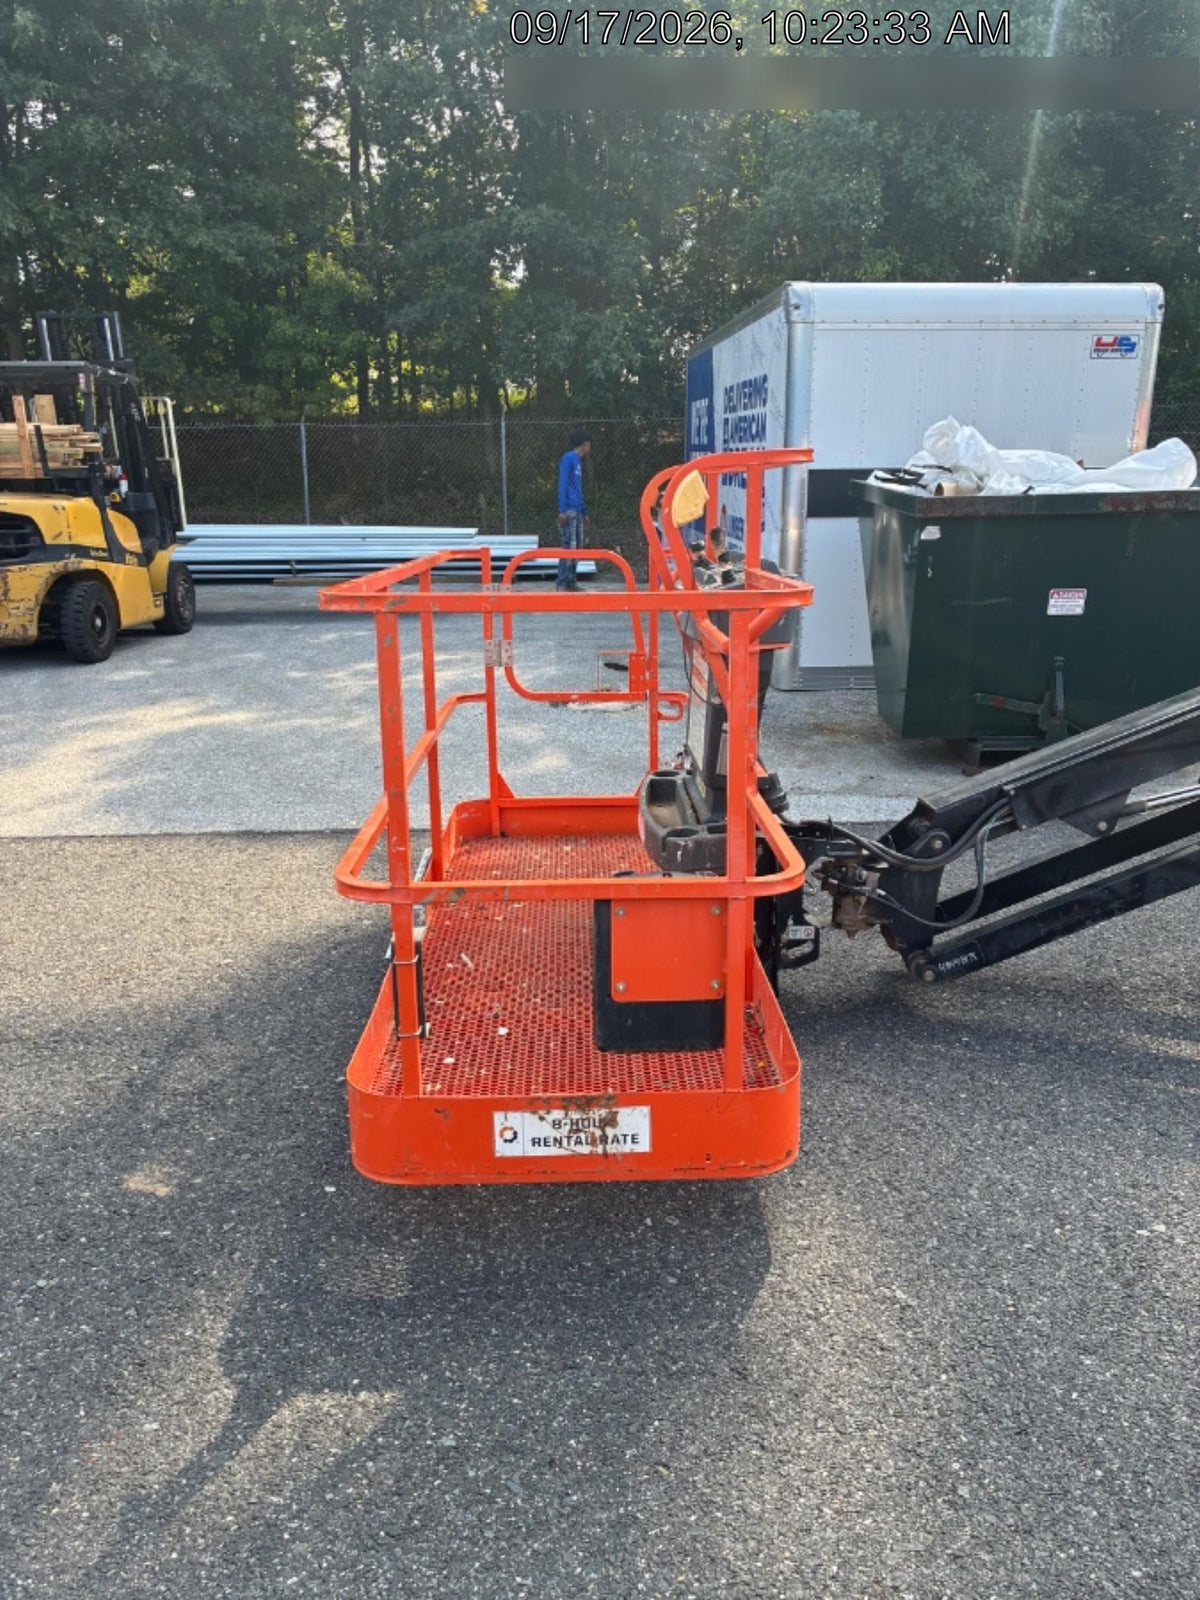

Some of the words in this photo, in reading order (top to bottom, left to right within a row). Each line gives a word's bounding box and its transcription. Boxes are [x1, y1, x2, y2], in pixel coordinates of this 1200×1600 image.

[723, 374, 768, 415] DELIVERING
[731, 411, 767, 444] AMERICAN
[531, 1134, 590, 1148] RENTAL
[599, 1133, 640, 1146] RATE
